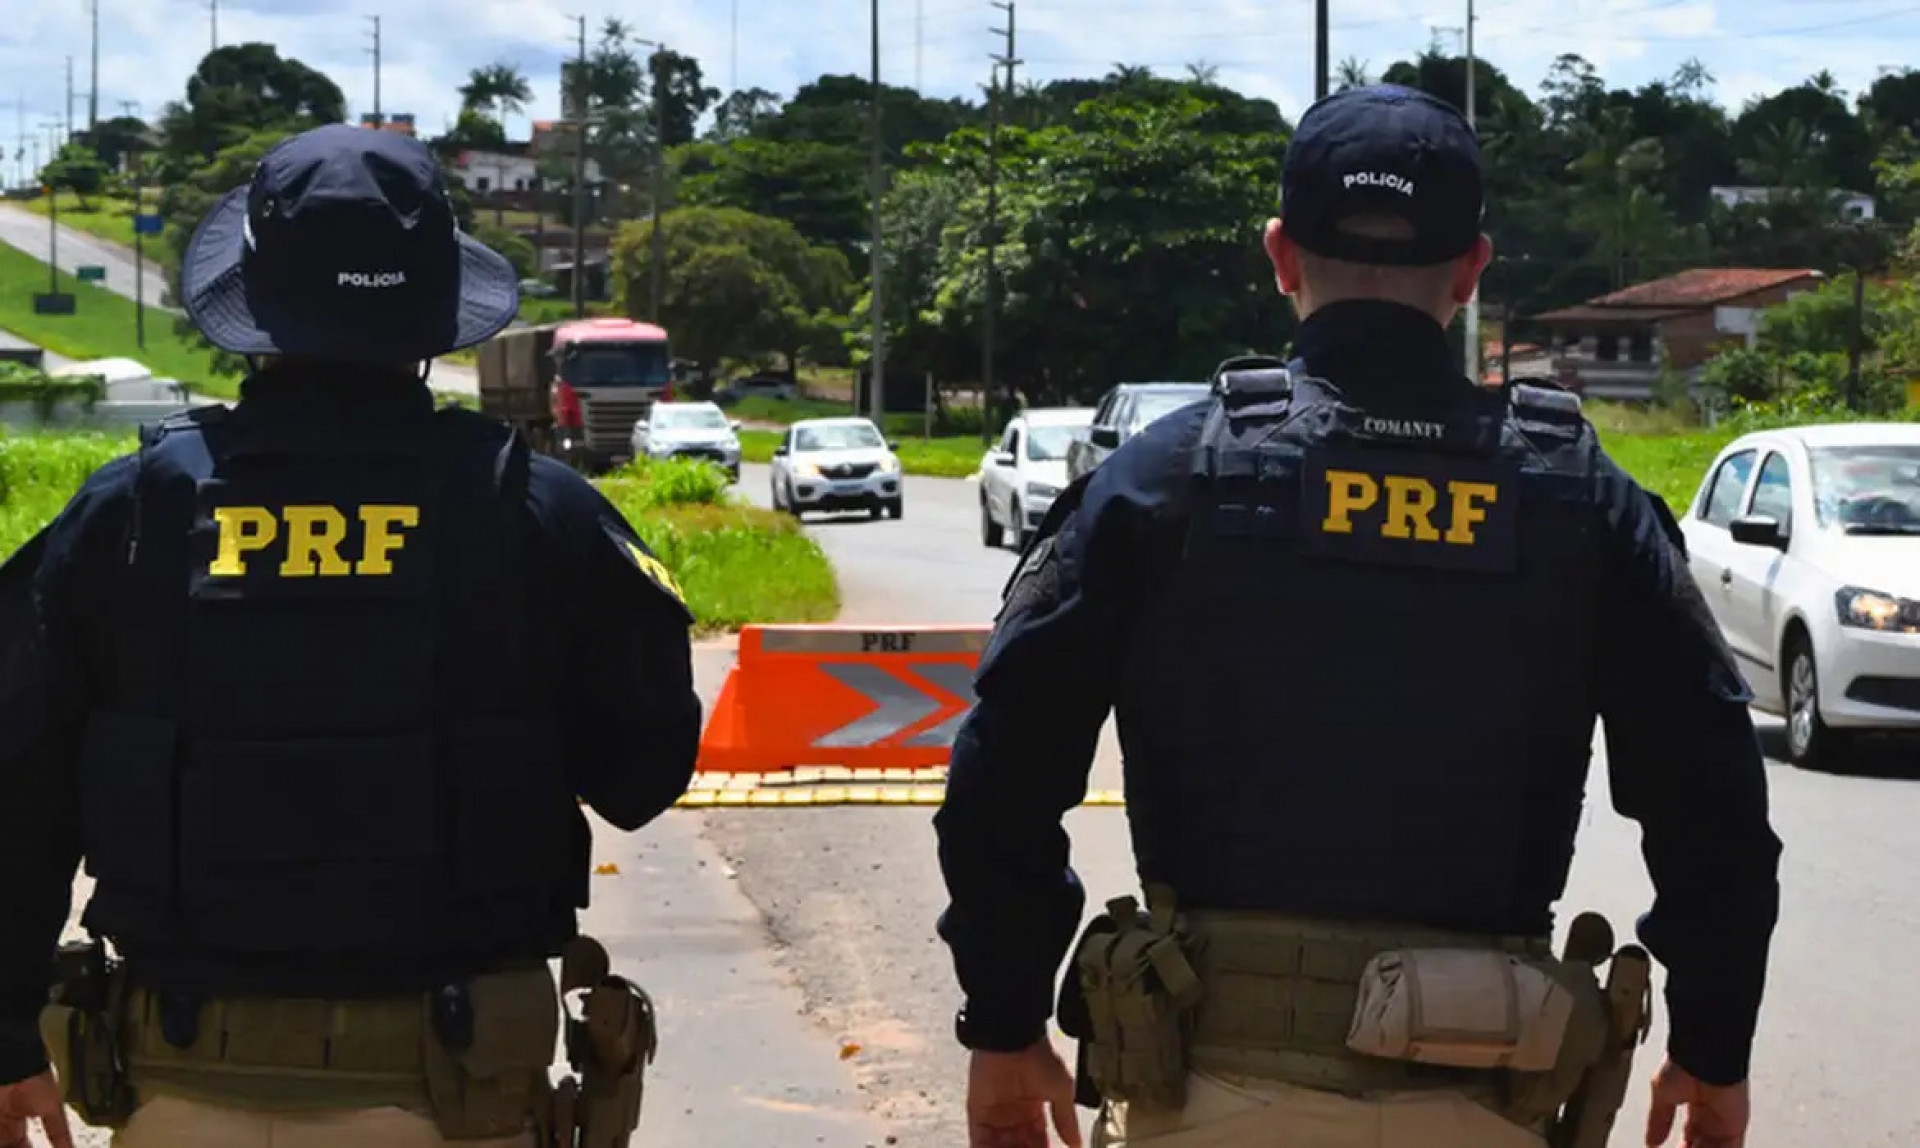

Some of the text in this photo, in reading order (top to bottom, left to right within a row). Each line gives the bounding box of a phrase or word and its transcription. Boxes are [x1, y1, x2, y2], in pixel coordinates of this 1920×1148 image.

[209, 504, 420, 577] PRF
[1321, 469, 1498, 545] PRF
[861, 631, 917, 652] PRF
